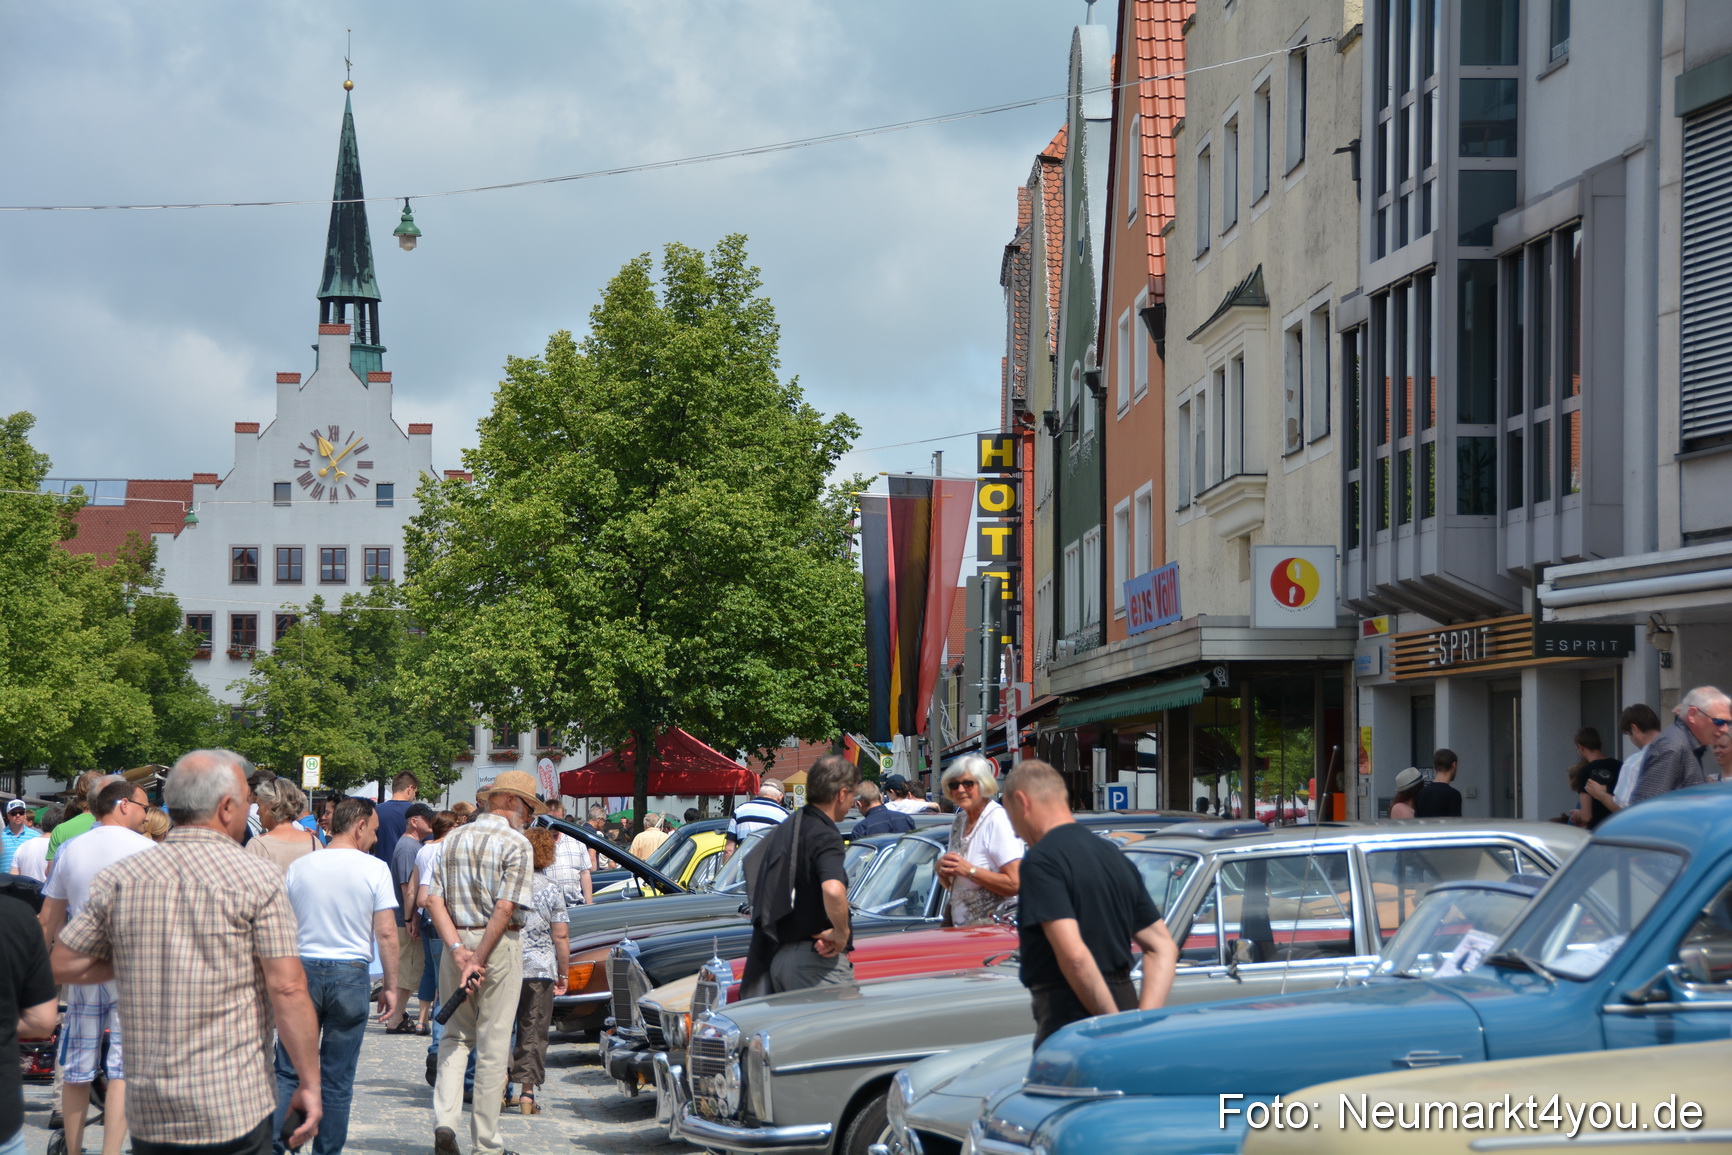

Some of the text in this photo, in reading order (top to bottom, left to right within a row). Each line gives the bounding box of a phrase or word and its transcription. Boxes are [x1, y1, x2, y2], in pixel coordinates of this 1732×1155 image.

[978, 439, 1015, 644] HOTE
[1429, 627, 1488, 665] ESPRIT
[1545, 639, 1618, 652] ESPRIT
[1113, 791, 1125, 809] P
